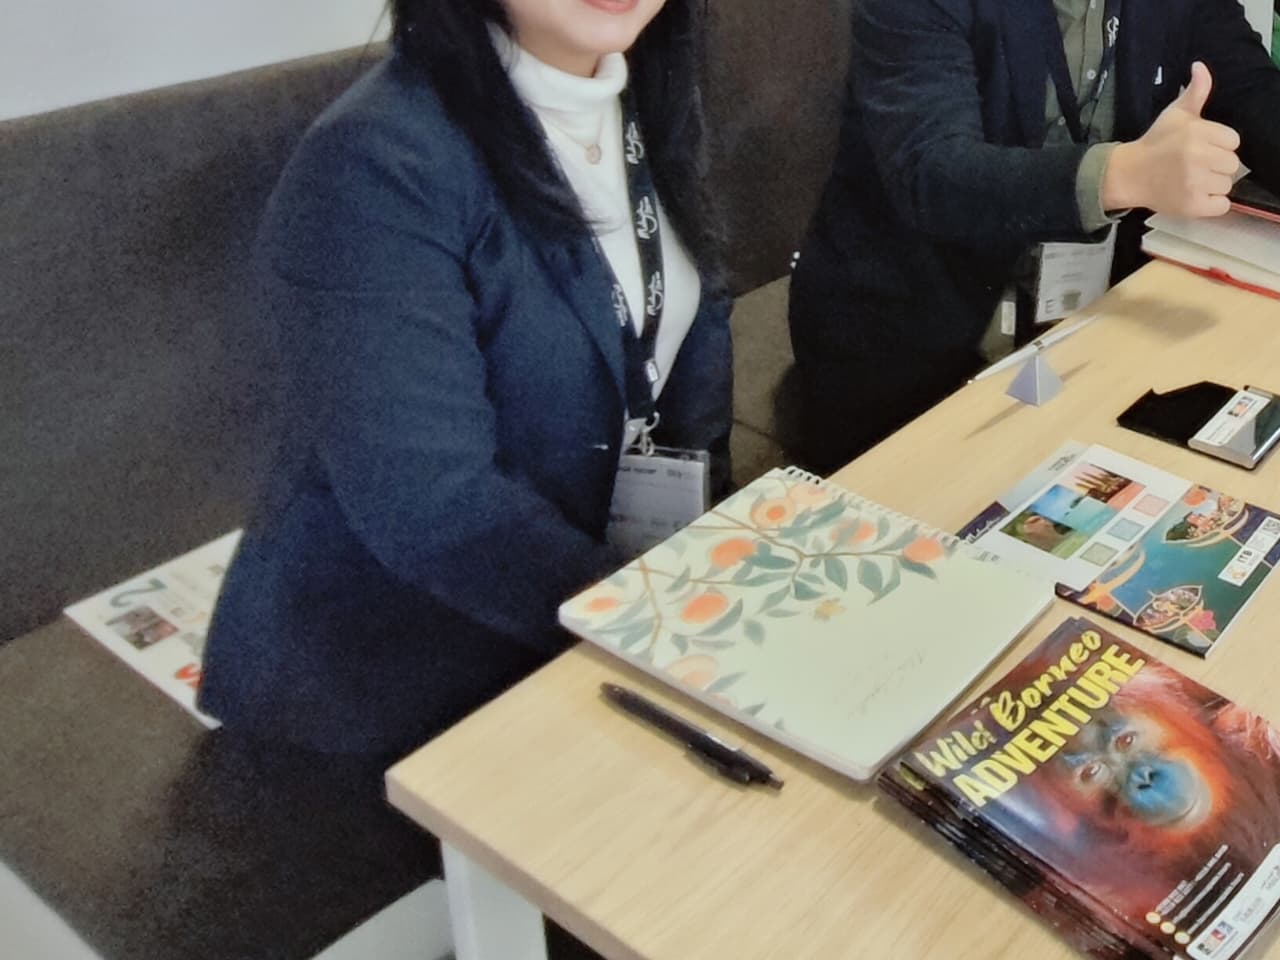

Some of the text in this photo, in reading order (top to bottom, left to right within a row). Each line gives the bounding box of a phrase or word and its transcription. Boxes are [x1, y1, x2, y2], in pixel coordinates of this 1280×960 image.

[915, 719, 998, 778] Wild
[989, 630, 1103, 732] Borneo
[952, 644, 1146, 808] ADVENTURE
